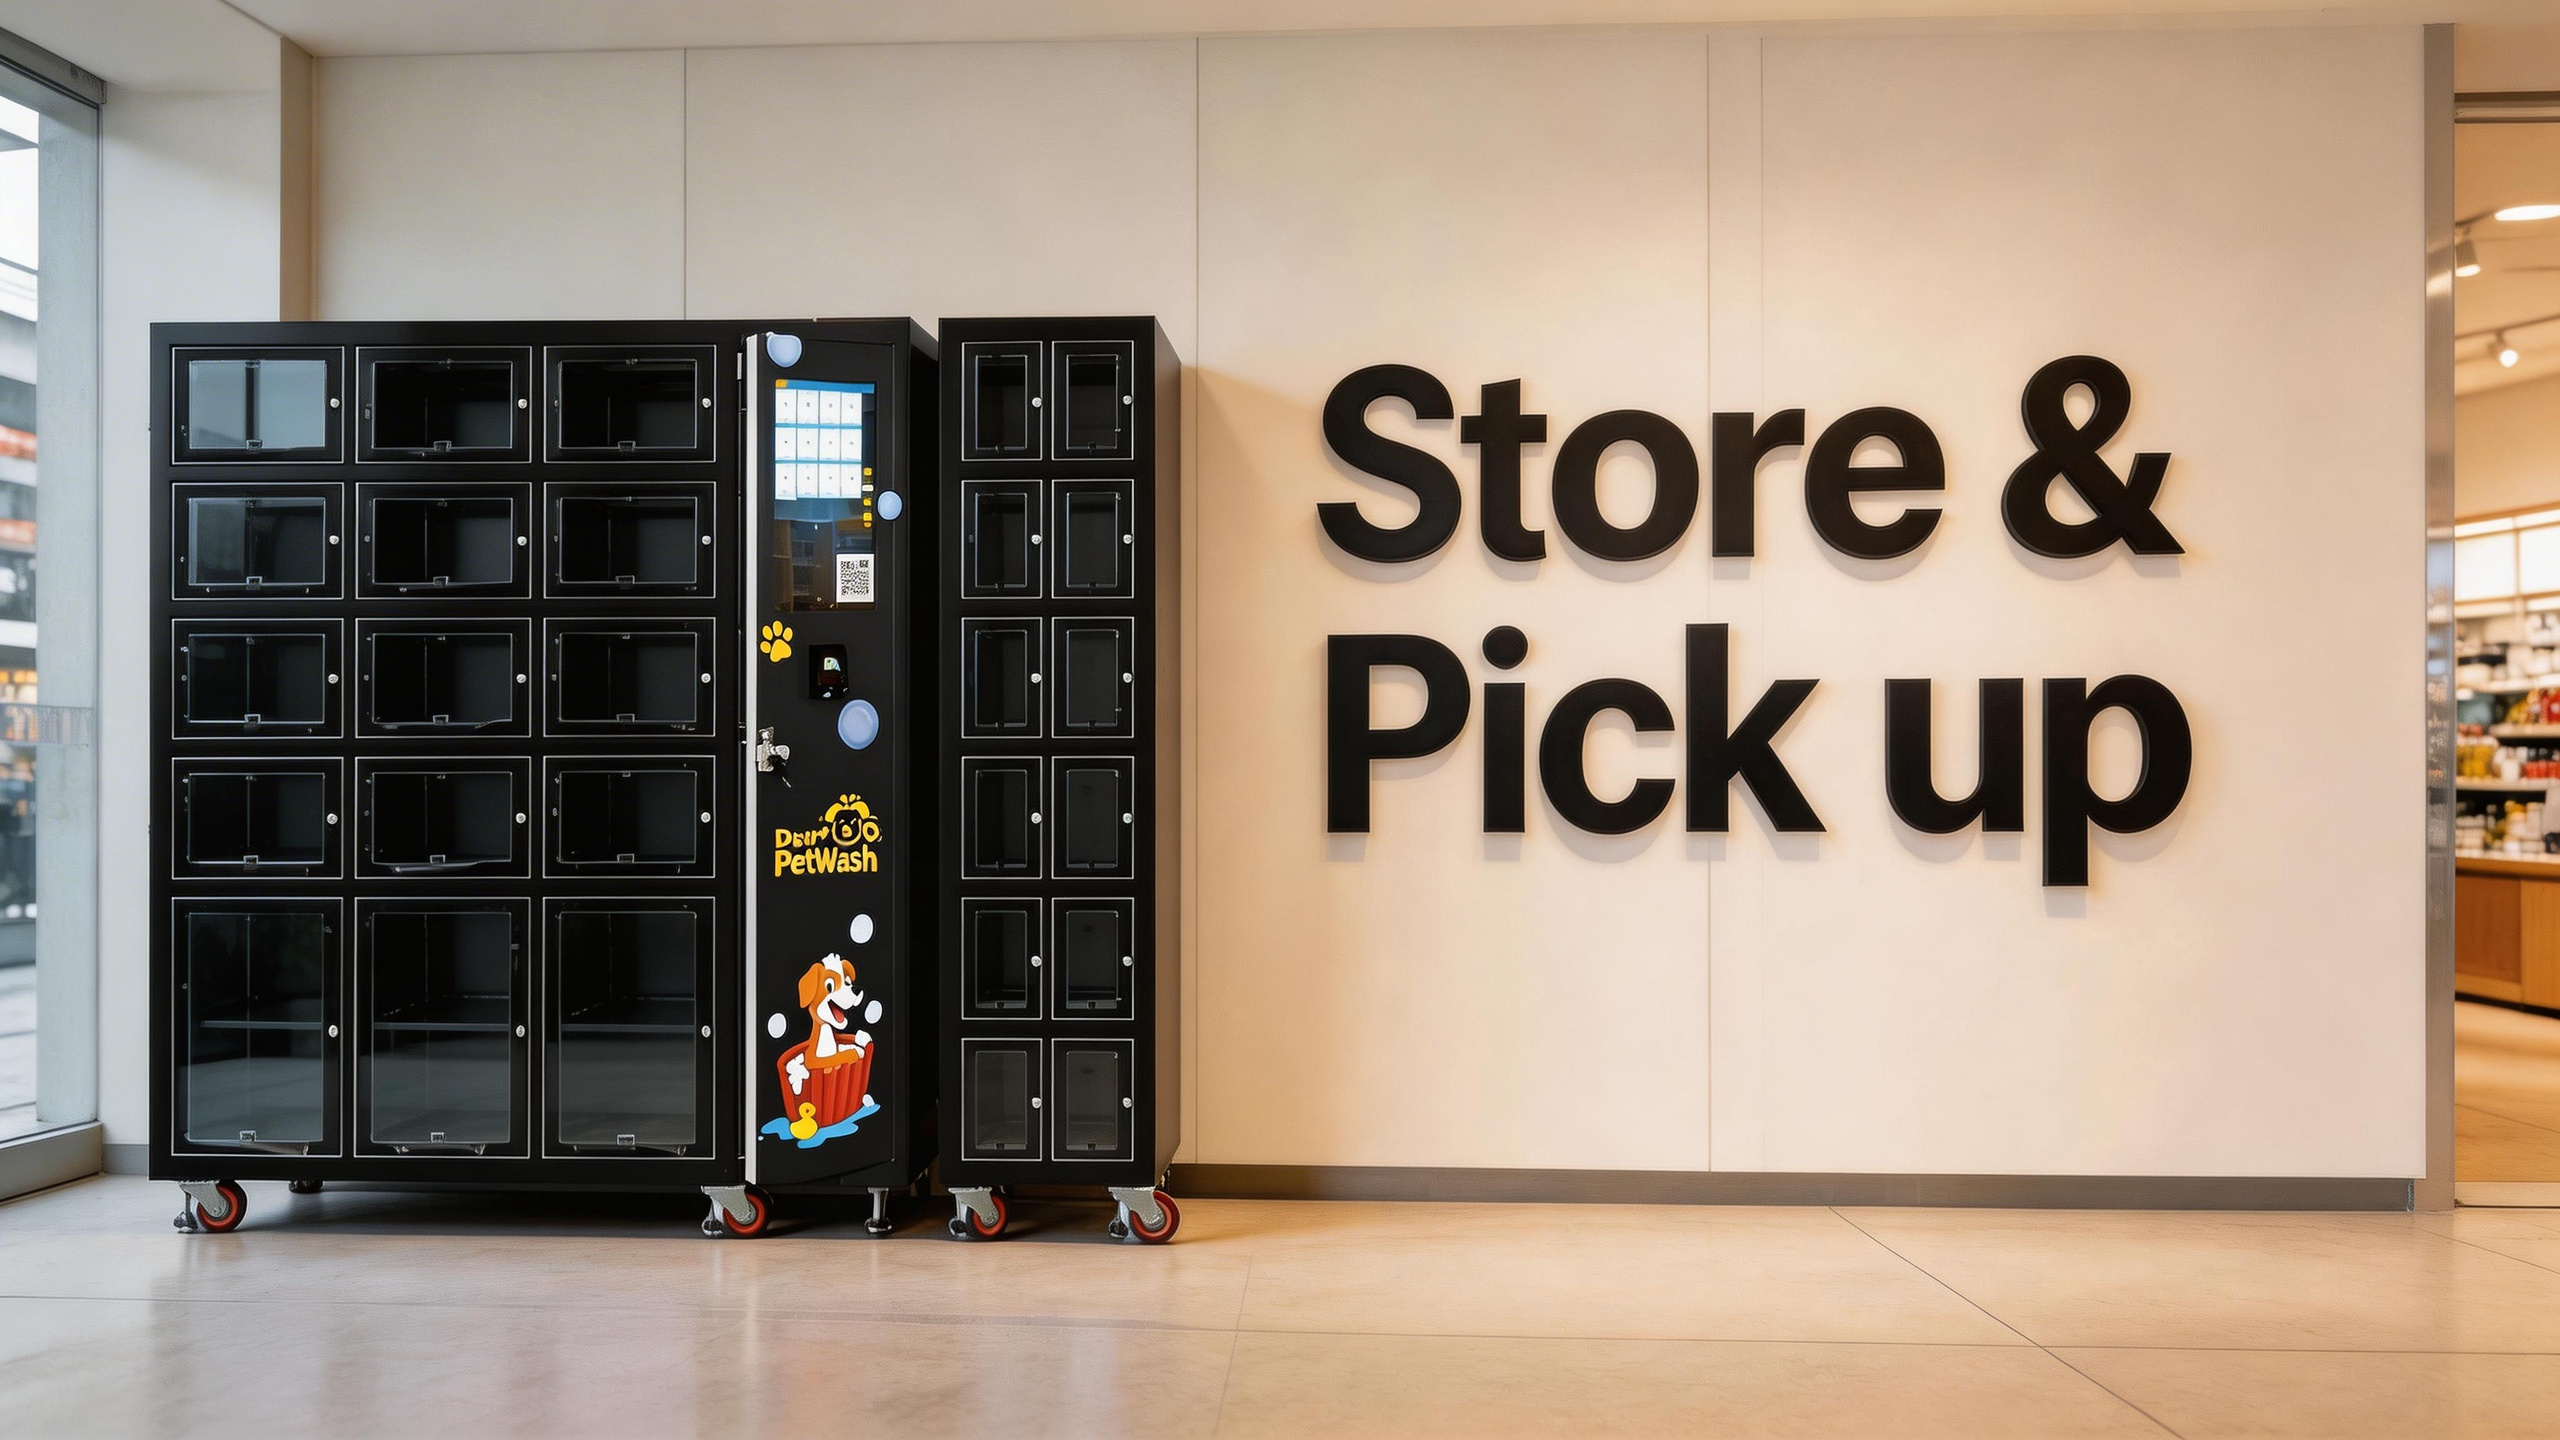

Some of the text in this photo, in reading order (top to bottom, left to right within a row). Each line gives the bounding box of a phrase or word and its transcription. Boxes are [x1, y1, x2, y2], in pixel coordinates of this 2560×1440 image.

[1317, 355, 2186, 564] Store &
[1326, 624, 2193, 887] Pick up
[774, 844, 879, 878] PetWash
